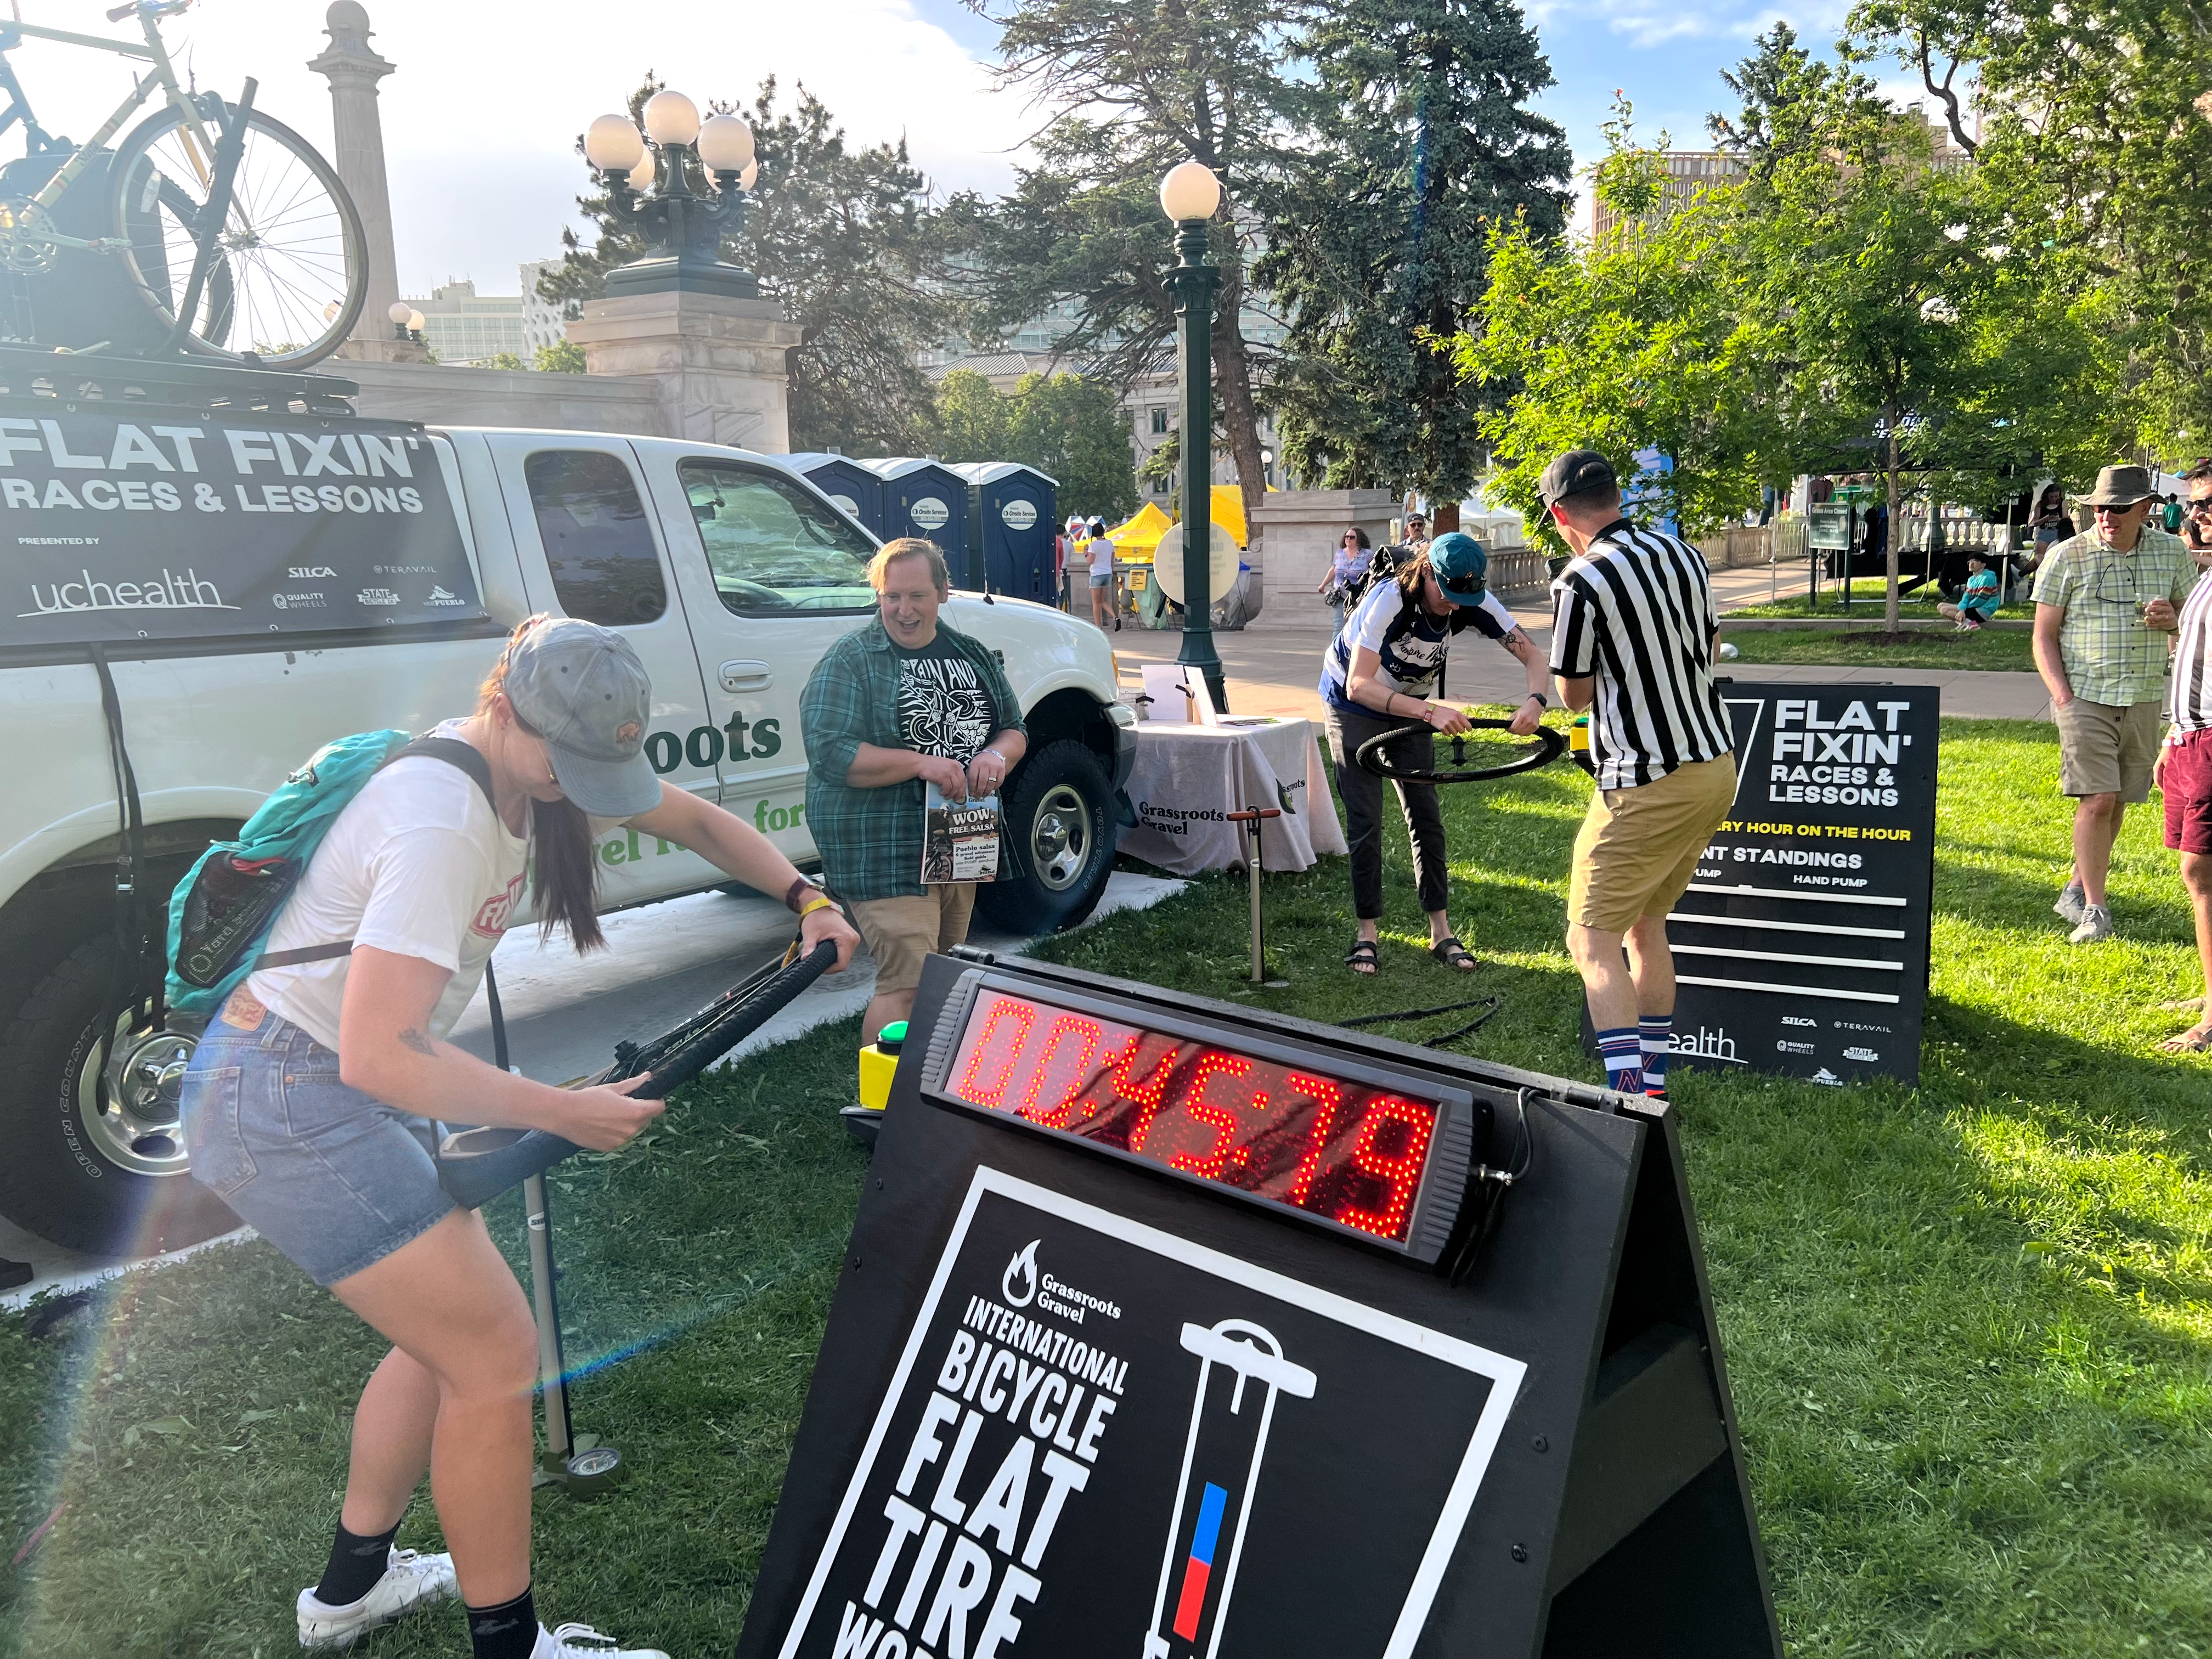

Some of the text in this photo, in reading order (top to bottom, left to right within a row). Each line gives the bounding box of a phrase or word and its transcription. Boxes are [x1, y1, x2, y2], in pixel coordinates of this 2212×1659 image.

[223, 428, 419, 478] FIXIN'
[1, 478, 424, 514] RACES & LESSONS
[18, 537, 83, 545] PRESENTED
[289, 567, 337, 578] SILCA
[31, 568, 223, 611] uchealth
[288, 600, 327, 608] WHEELS
[363, 589, 392, 598] STATE
[909, 658, 977, 692] PAIN AND
[1775, 699, 1910, 731] FLAT
[644, 710, 781, 774] oots
[1773, 732, 1911, 765] FIXIN'
[1770, 765, 1895, 786] RACES &
[1139, 801, 1224, 822] Grassroots
[1769, 785, 1899, 807] LESSONS
[949, 823, 995, 834] FREE SALSA
[952, 808, 995, 826] WOW.
[1095, 806, 1105, 847] TOYO
[1141, 816, 1188, 835] Gravel
[1747, 822, 1793, 836] HOUR
[1797, 824, 1821, 837] ON
[1825, 826, 1858, 839] THE
[1861, 827, 1911, 841] HOUR
[1082, 847, 1104, 891] TIRES
[1699, 845, 1863, 869] NT STANDINGS
[1793, 874, 1867, 888] HAND PUMP
[1781, 1016, 1818, 1028] SILCA
[1843, 1022, 1892, 1033] TERAVAIL
[1669, 1025, 1735, 1059] ealth
[1786, 1046, 1814, 1055] WHEELS
[1849, 1046, 1873, 1056] STATE
[60, 1015, 98, 1113] COUNT
[61, 1120, 103, 1178] OPEN
[1037, 1292, 1085, 1324] Gravel
[1042, 1273, 1121, 1319] Grassroots
[962, 1295, 1128, 1397] INTERNATIONAL
[937, 1328, 1117, 1463] BICYCLE
[895, 1390, 1091, 1570] FLAT
[863, 1494, 1042, 1659] TIRE
